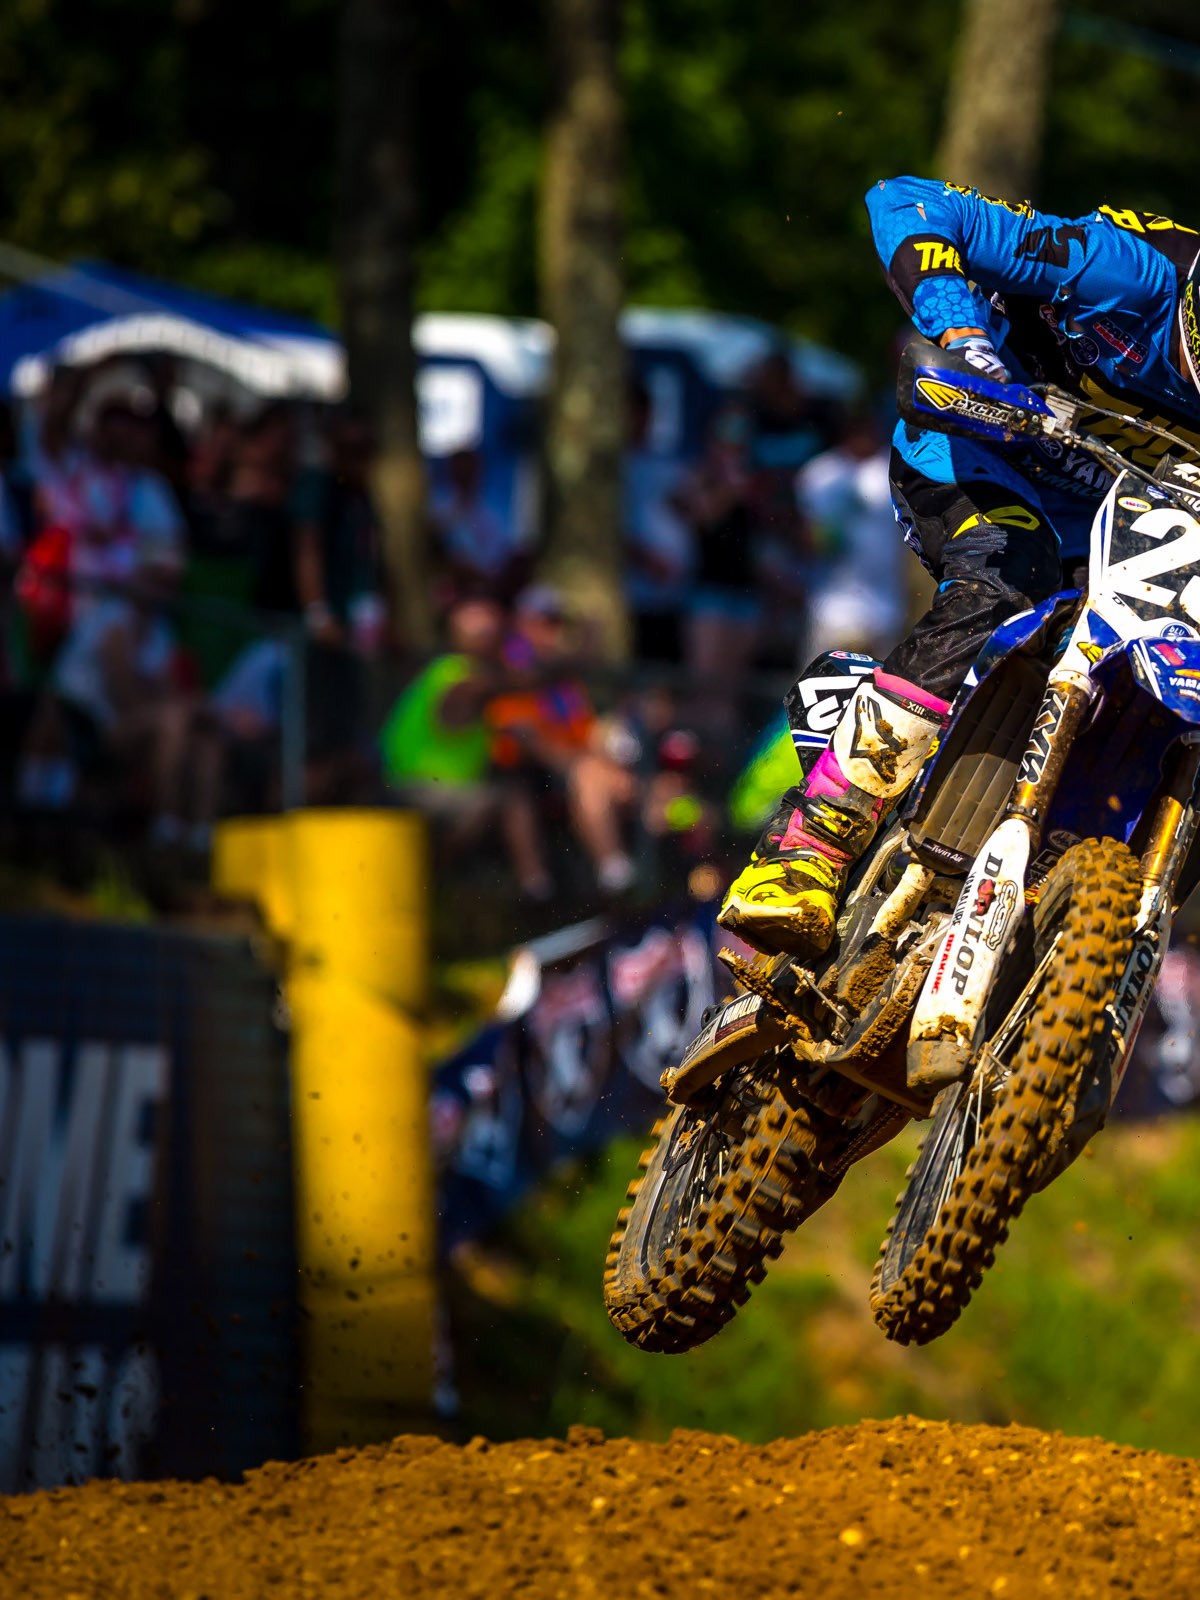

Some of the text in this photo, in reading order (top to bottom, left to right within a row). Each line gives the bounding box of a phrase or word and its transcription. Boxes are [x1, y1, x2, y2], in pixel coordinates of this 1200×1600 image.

[951, 397, 1009, 423] CYCRA
[931, 843, 964, 863] Twin Air
[951, 851, 1003, 997] DNLOP
